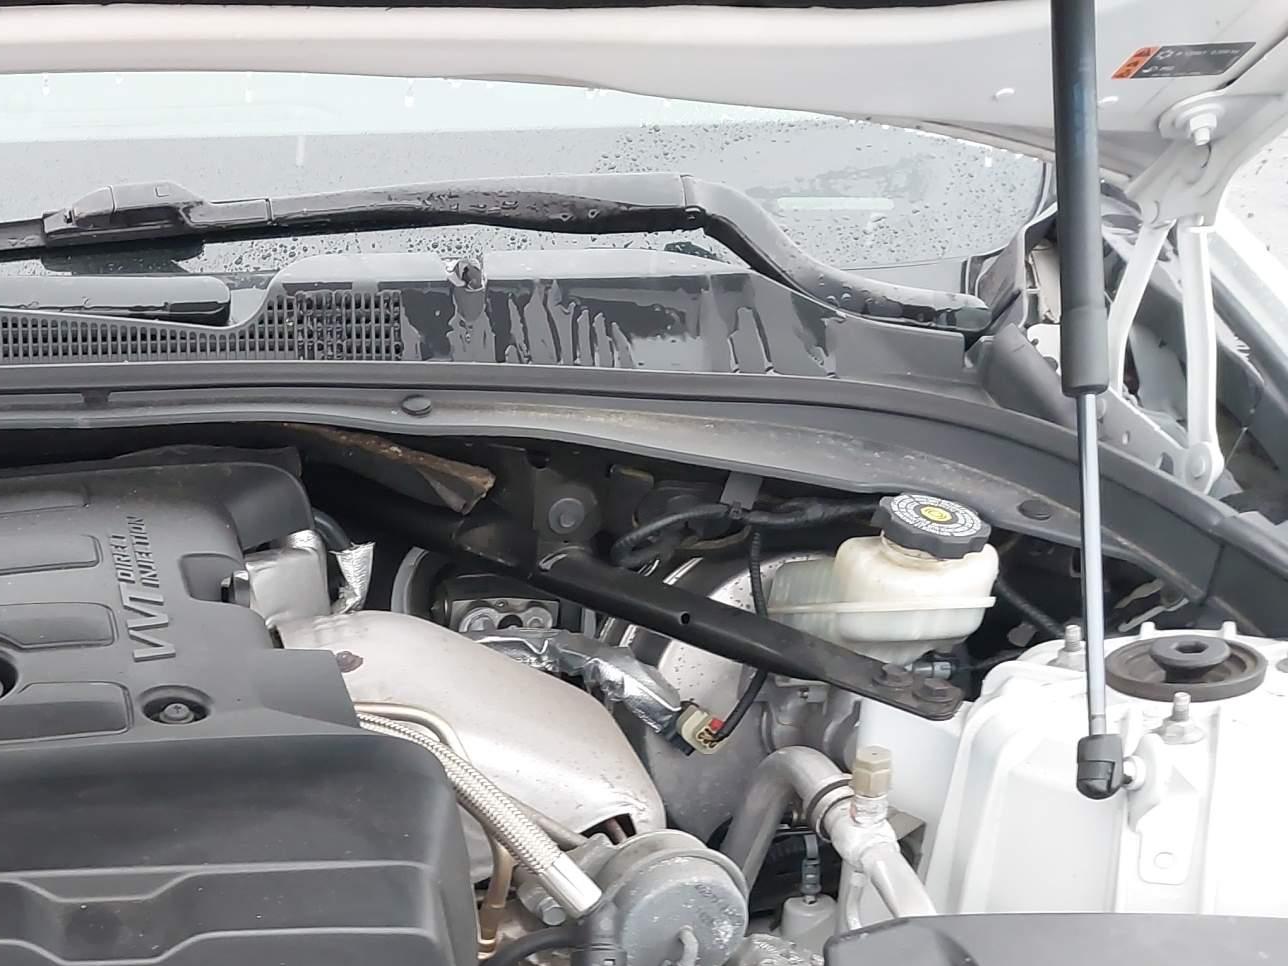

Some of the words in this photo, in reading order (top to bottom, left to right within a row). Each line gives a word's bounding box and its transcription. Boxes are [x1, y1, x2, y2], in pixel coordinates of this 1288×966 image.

[111, 534, 136, 584] DIRECT
[126, 515, 160, 589] INJECTION
[119, 583, 177, 663] VVT
